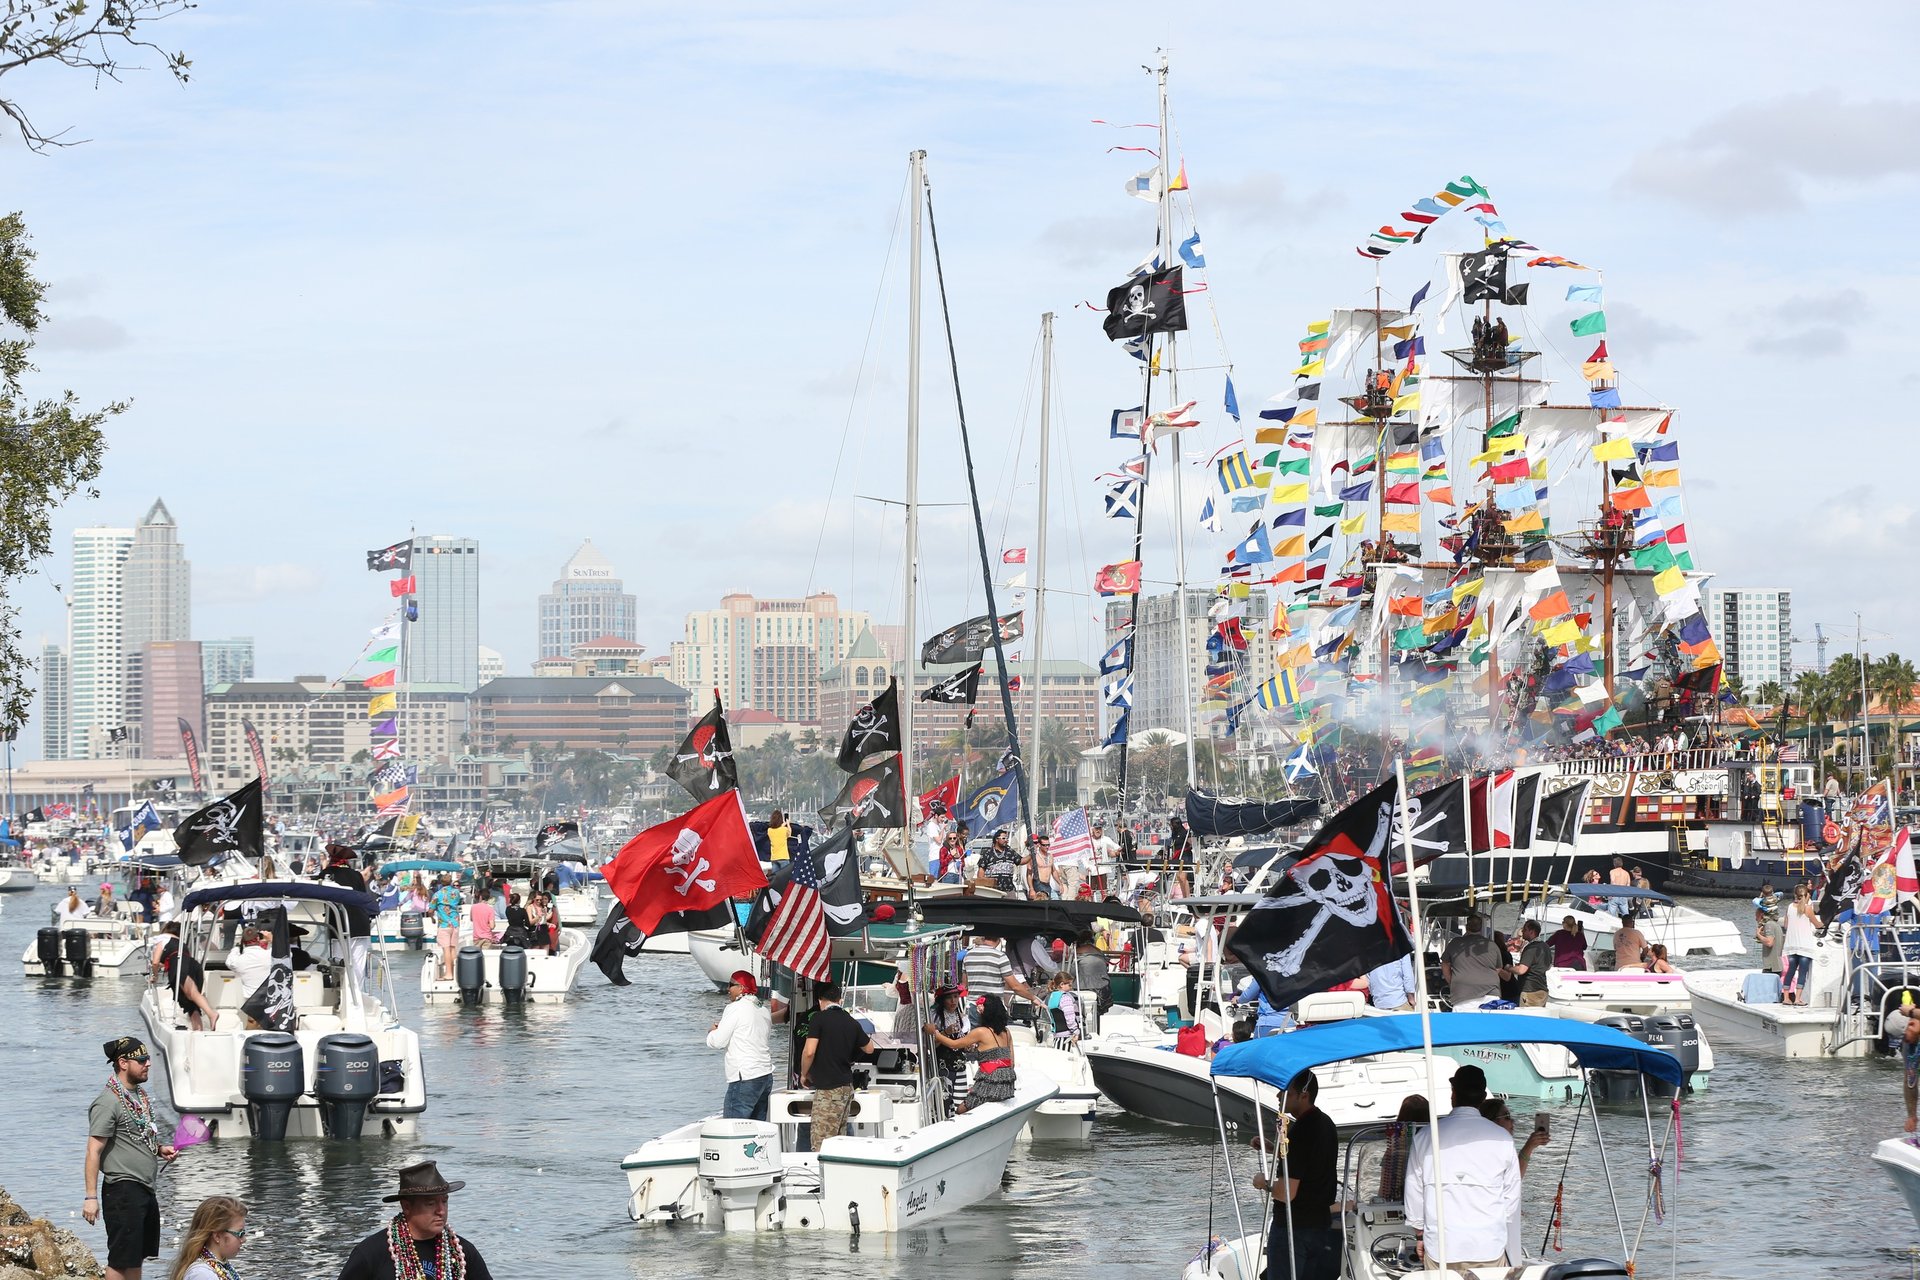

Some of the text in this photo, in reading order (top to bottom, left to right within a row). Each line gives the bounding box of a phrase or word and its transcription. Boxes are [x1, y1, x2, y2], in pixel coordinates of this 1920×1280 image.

[1682, 1039, 1698, 1047] 200
[1463, 1048, 1511, 1061] SAILFISH
[267, 1061, 292, 1069] 200
[346, 1061, 369, 1069] 200
[703, 1152, 720, 1161] 150
